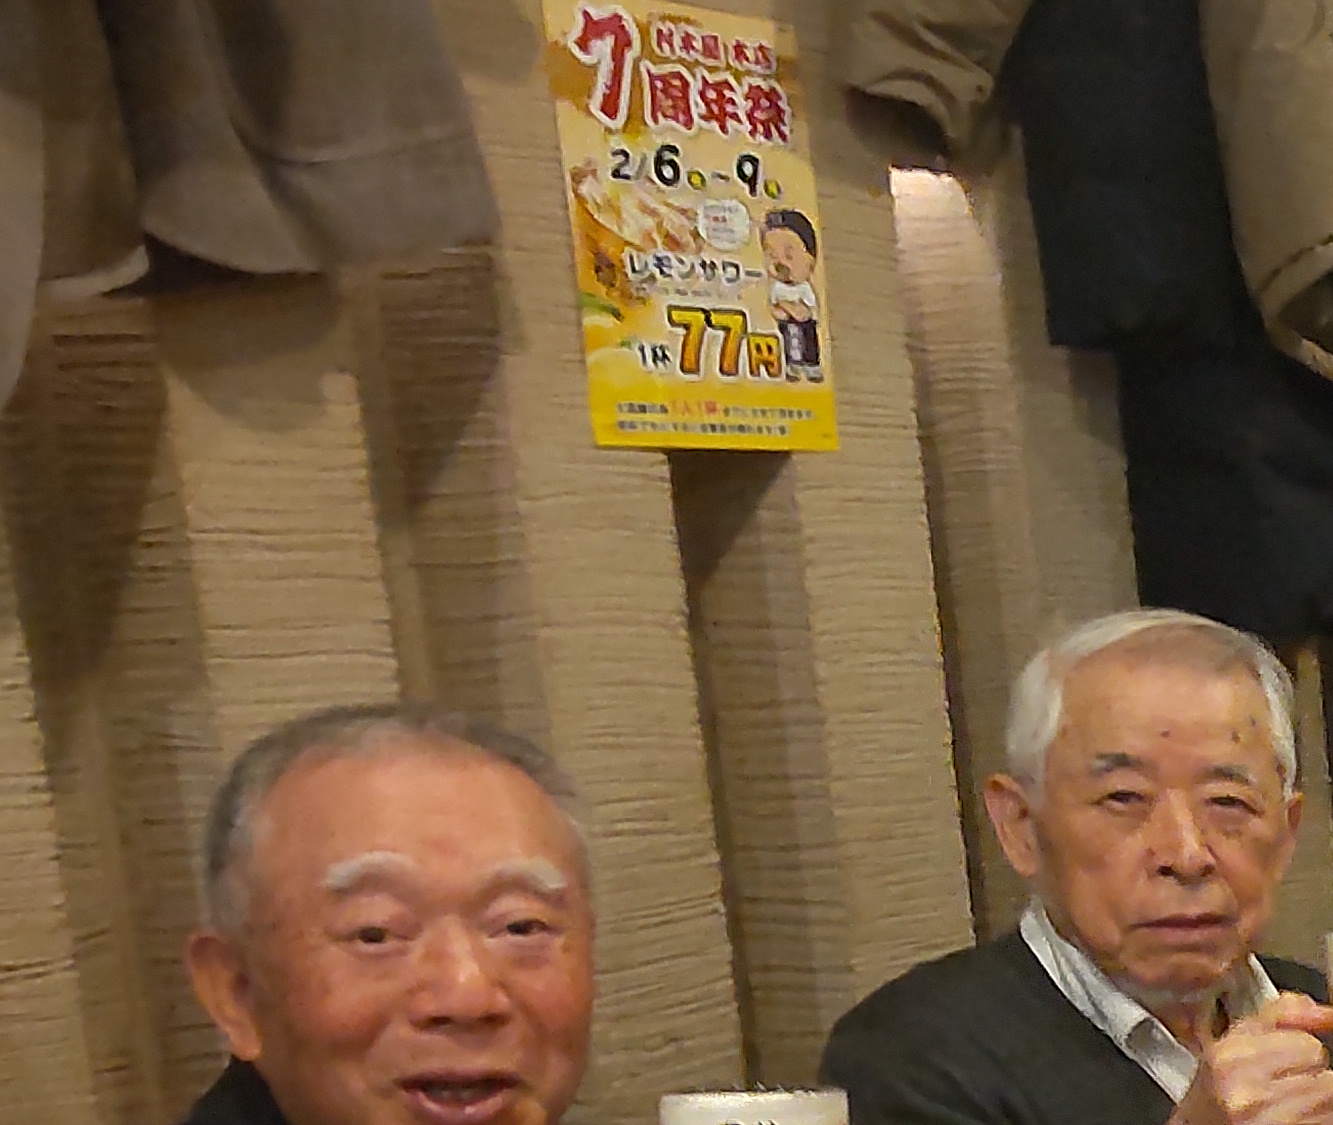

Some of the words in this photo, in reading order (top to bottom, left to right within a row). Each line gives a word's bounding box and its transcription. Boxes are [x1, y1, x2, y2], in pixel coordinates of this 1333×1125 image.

[628, 252, 764, 284] レモンサワー
